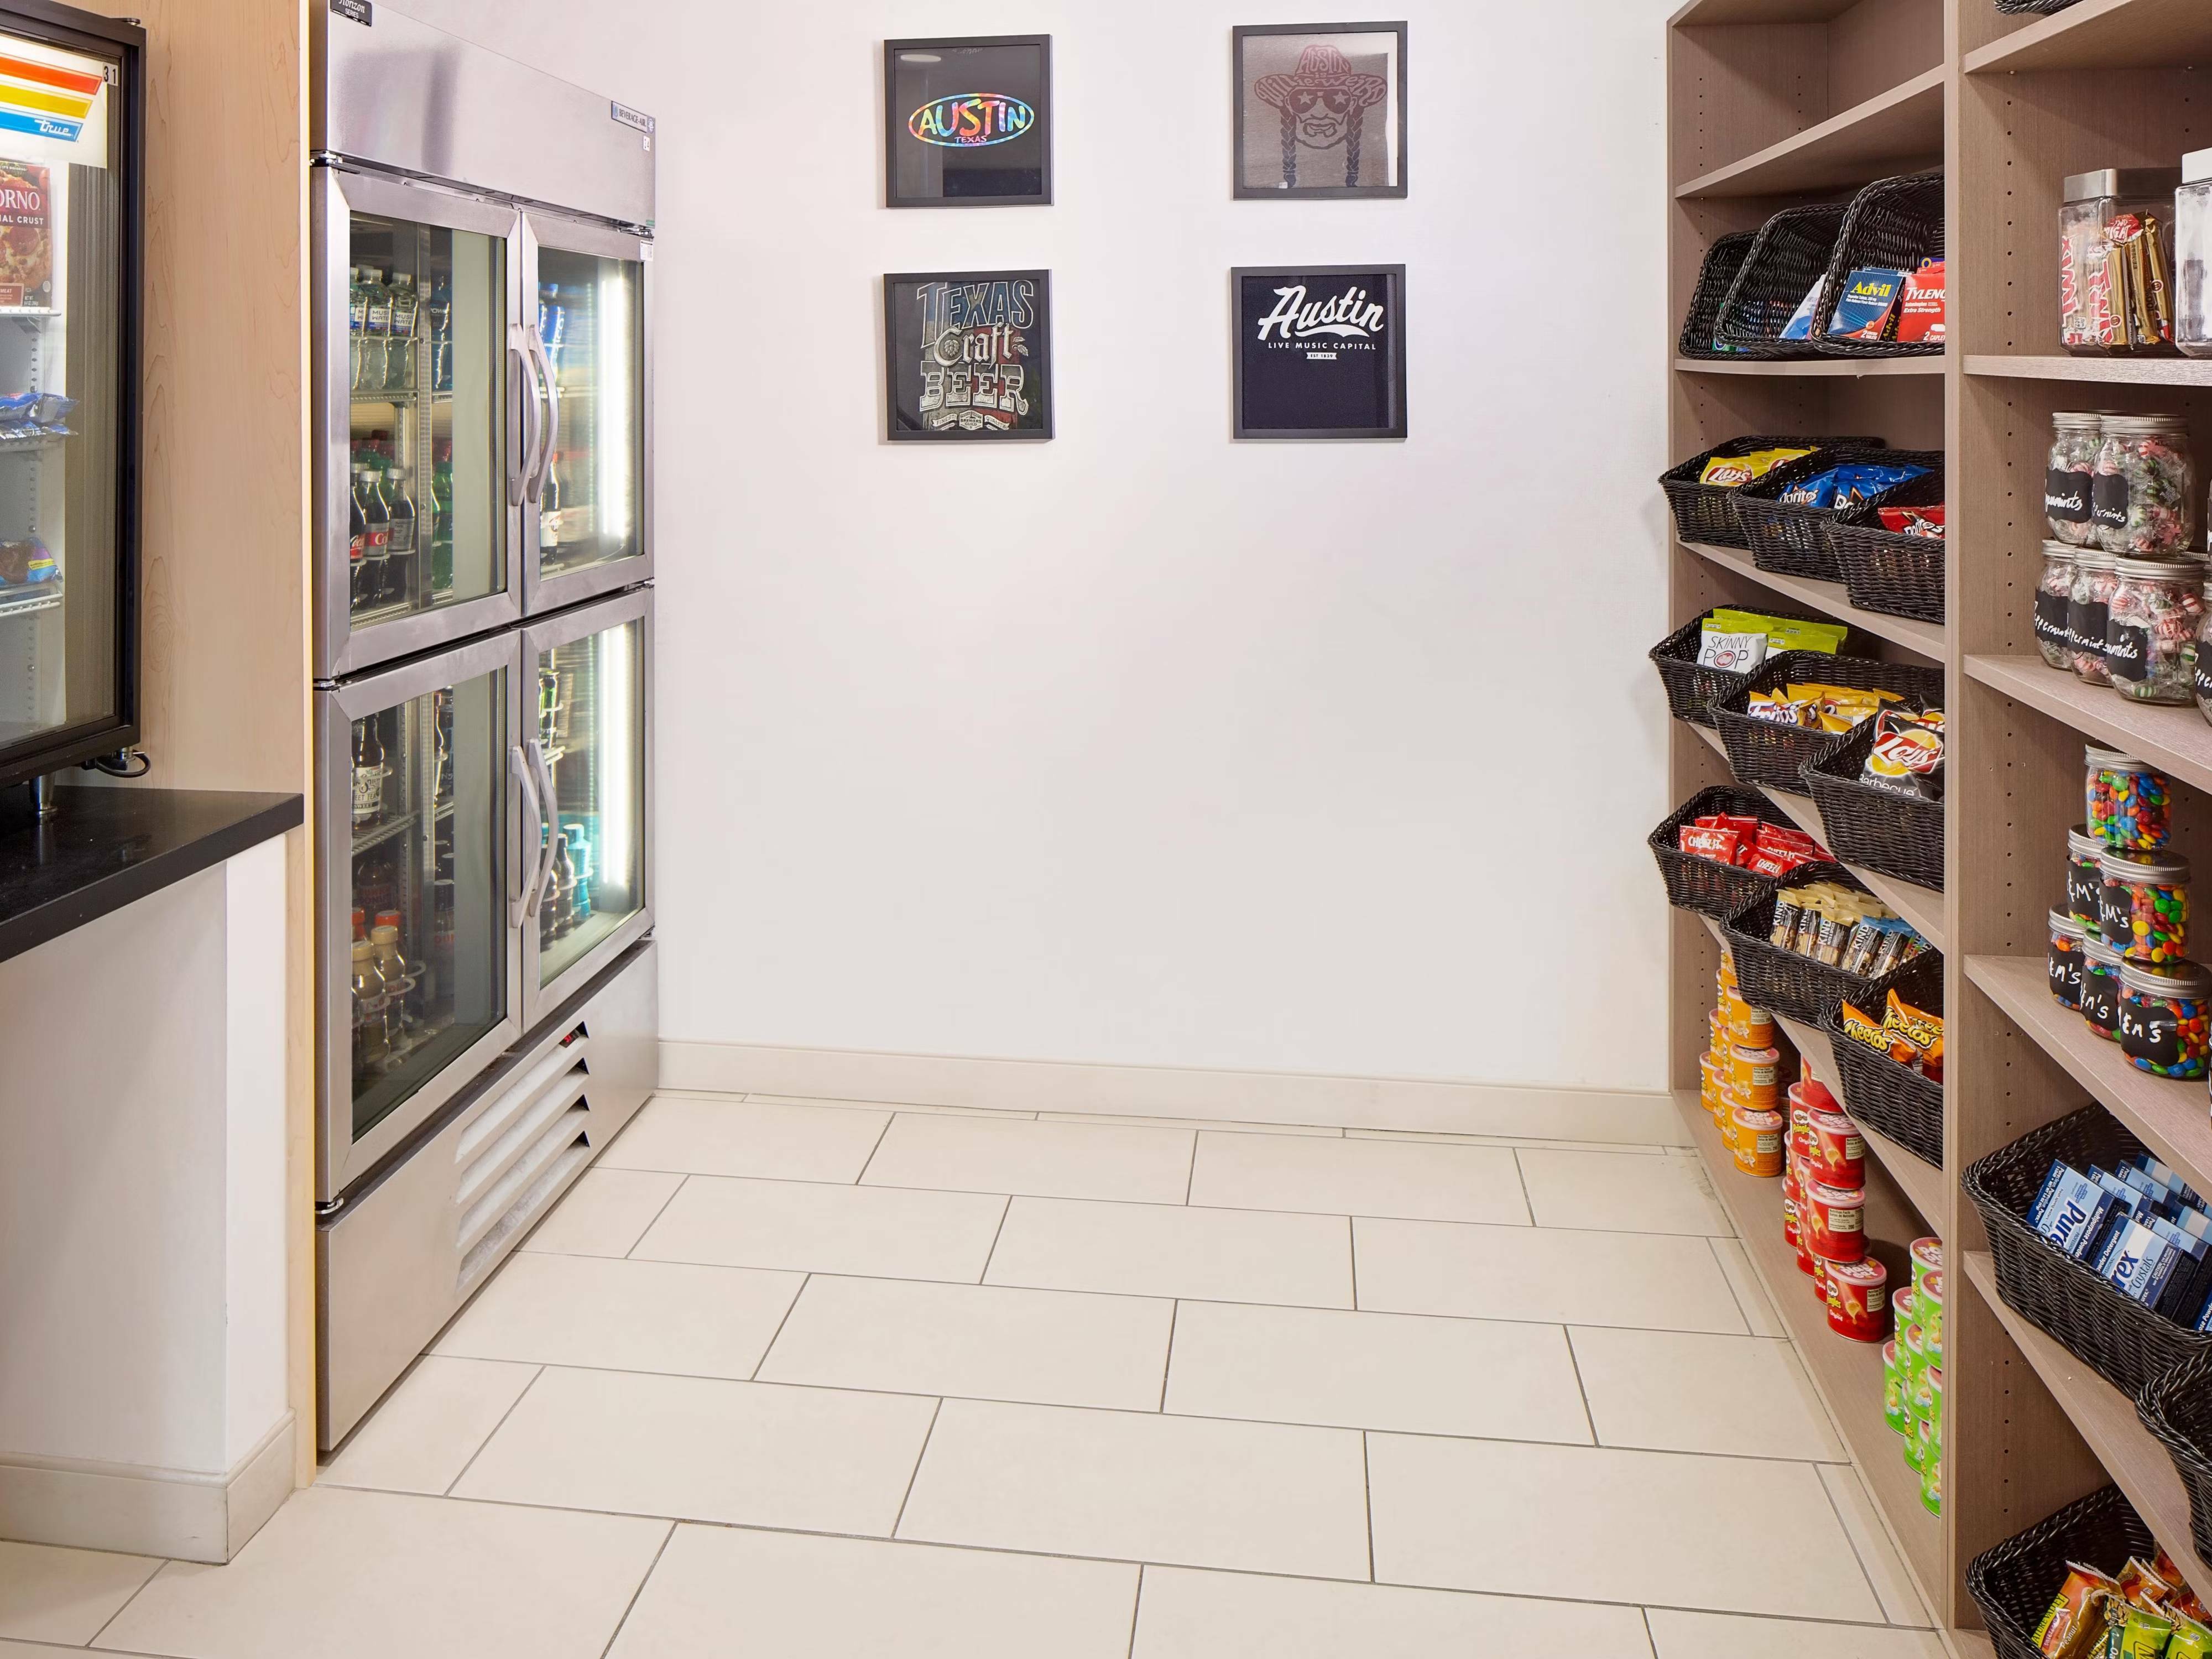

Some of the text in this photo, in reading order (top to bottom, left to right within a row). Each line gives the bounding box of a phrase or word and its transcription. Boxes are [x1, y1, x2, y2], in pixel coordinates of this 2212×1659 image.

[345, 8, 359, 18] SERIES
[1296, 46, 1350, 73] AUSTIN
[104, 66, 116, 84] 31
[619, 109, 646, 127] BEVERAGE-AIR
[919, 98, 1025, 137] AUSTIN
[954, 135, 987, 143] TEXAS
[17, 216, 44, 225] CRUST
[1850, 281, 1892, 297] Advil
[917, 280, 1034, 348] TEXAS
[1258, 285, 1384, 341] Austin
[933, 322, 1014, 369] Craft
[1860, 330, 1868, 339] 2
[1923, 332, 1930, 341] 2
[920, 361, 1029, 415] BEER
[1708, 467, 1751, 484] Lay's
[1708, 635, 1752, 650] SKINNY
[1703, 648, 1749, 669] POP
[1873, 736, 1937, 766] Lay's
[1773, 900, 1785, 926] KIND
[1818, 919, 1832, 945] KIND
[1853, 924, 1870, 950] KIND
[1879, 930, 1894, 954] KIND
[1793, 1123, 1809, 1134] Pringle
[2048, 1199, 2089, 1246] Pure
[2083, 1206, 2104, 1240] Multipurpose
[2104, 1230, 2120, 1257] Detergent
[2111, 1250, 2138, 1288] rex
[2131, 1256, 2153, 1288] Crystals
[2151, 1261, 2163, 1279] CAUTION:
[2046, 1595, 2065, 1619] VALLEY
[2061, 1625, 2078, 1649] Peanut
